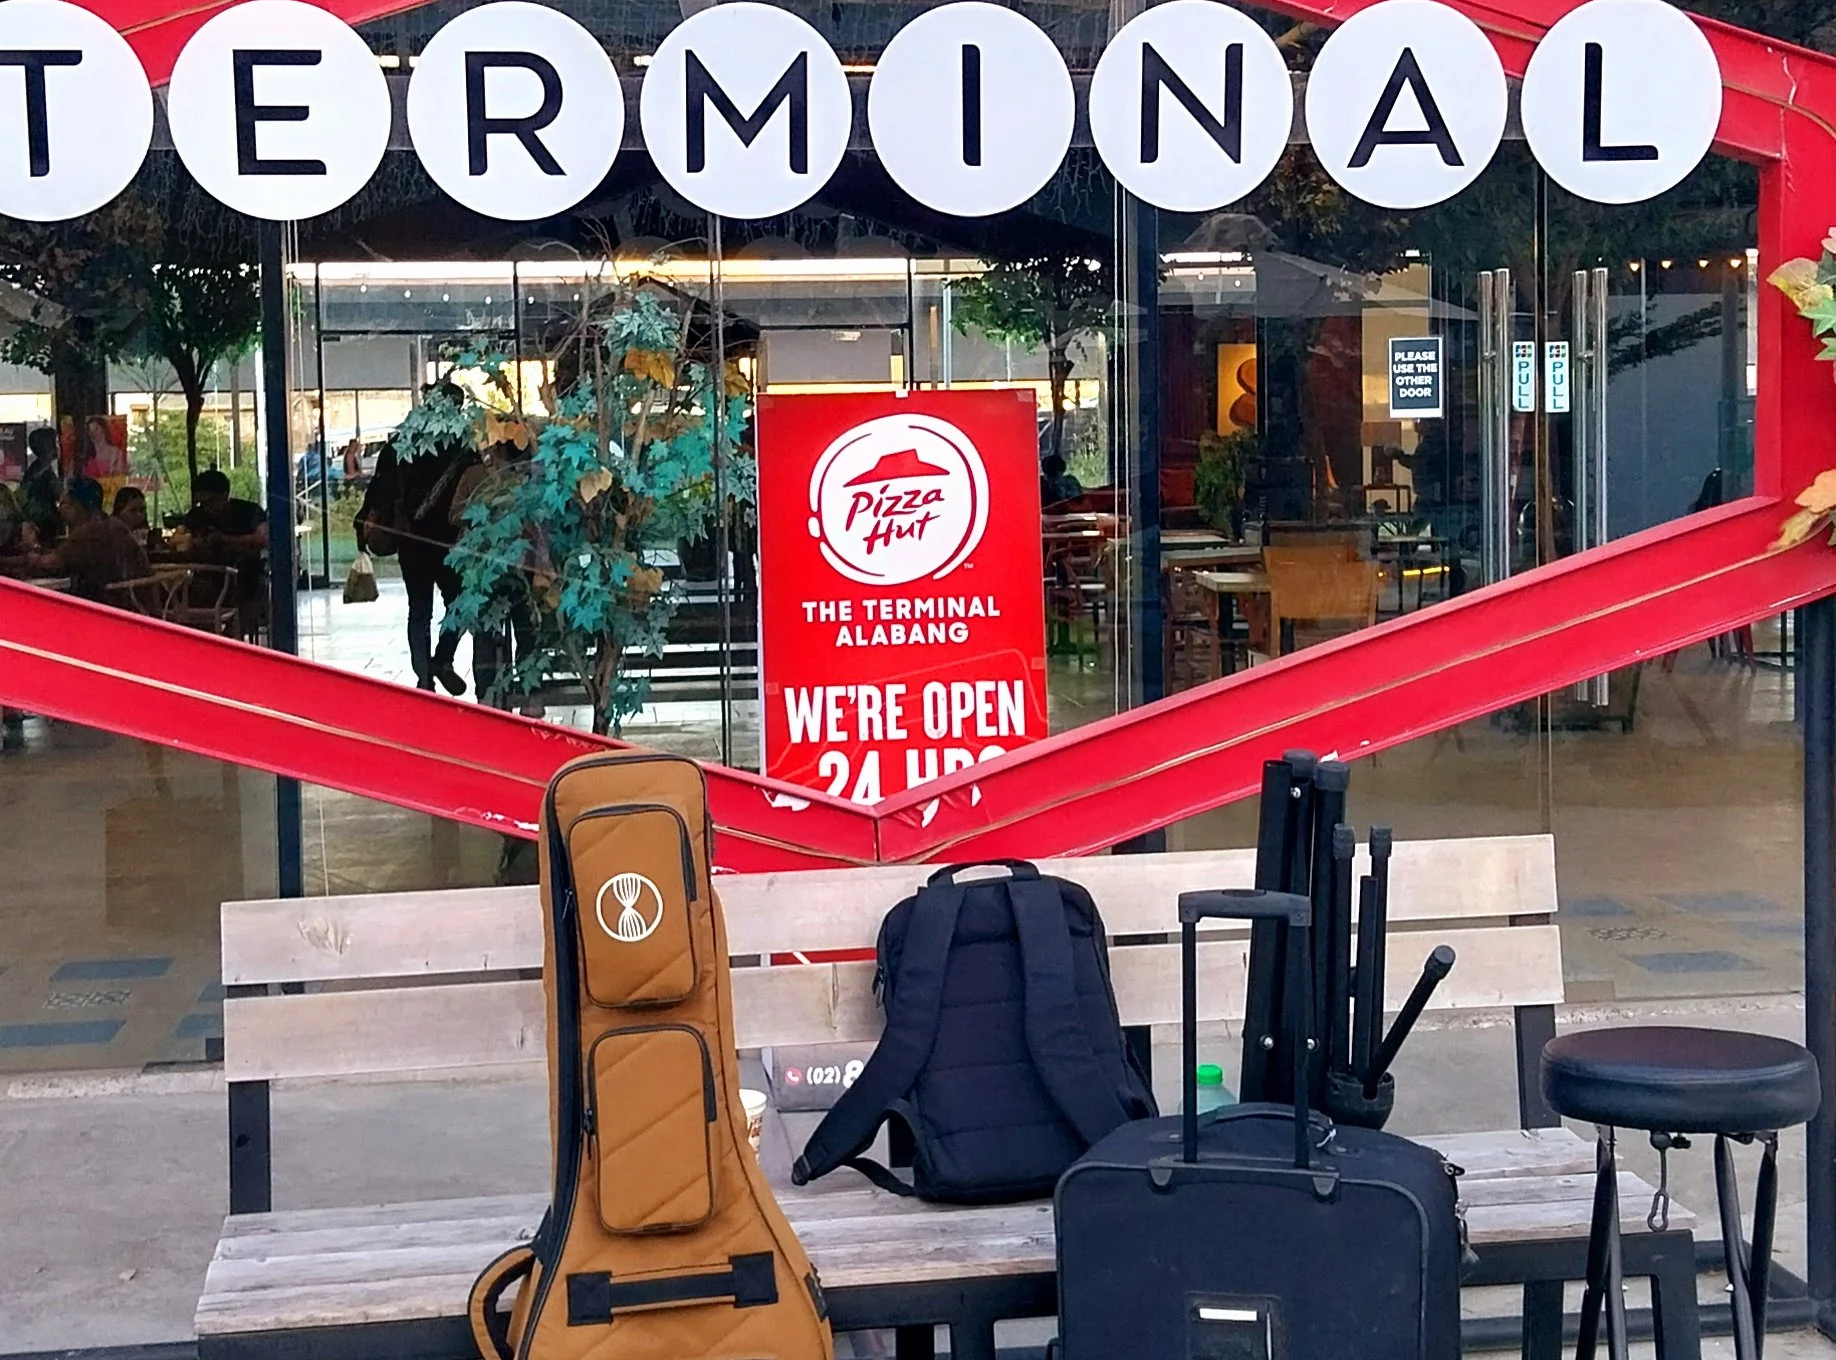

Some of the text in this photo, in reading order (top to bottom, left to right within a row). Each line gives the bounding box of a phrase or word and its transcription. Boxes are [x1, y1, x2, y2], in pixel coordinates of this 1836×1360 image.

[0, 42, 1659, 178] TERMINAL
[1392, 363, 1438, 374] USE THE
[1394, 351, 1436, 361] PLEASE
[1395, 375, 1433, 386] OTHER
[1399, 387, 1432, 398] DOOR
[1518, 361, 1530, 409] PULL
[1552, 361, 1564, 410] PULL
[845, 483, 945, 532] Pizza
[862, 510, 941, 555] Hut
[801, 595, 1001, 623] THE TERMINAL
[835, 621, 970, 648] ALABANG
[784, 679, 1026, 744] WE'RE OPEN
[818, 750, 886, 807] 24
[806, 1066, 841, 1085] (02)
